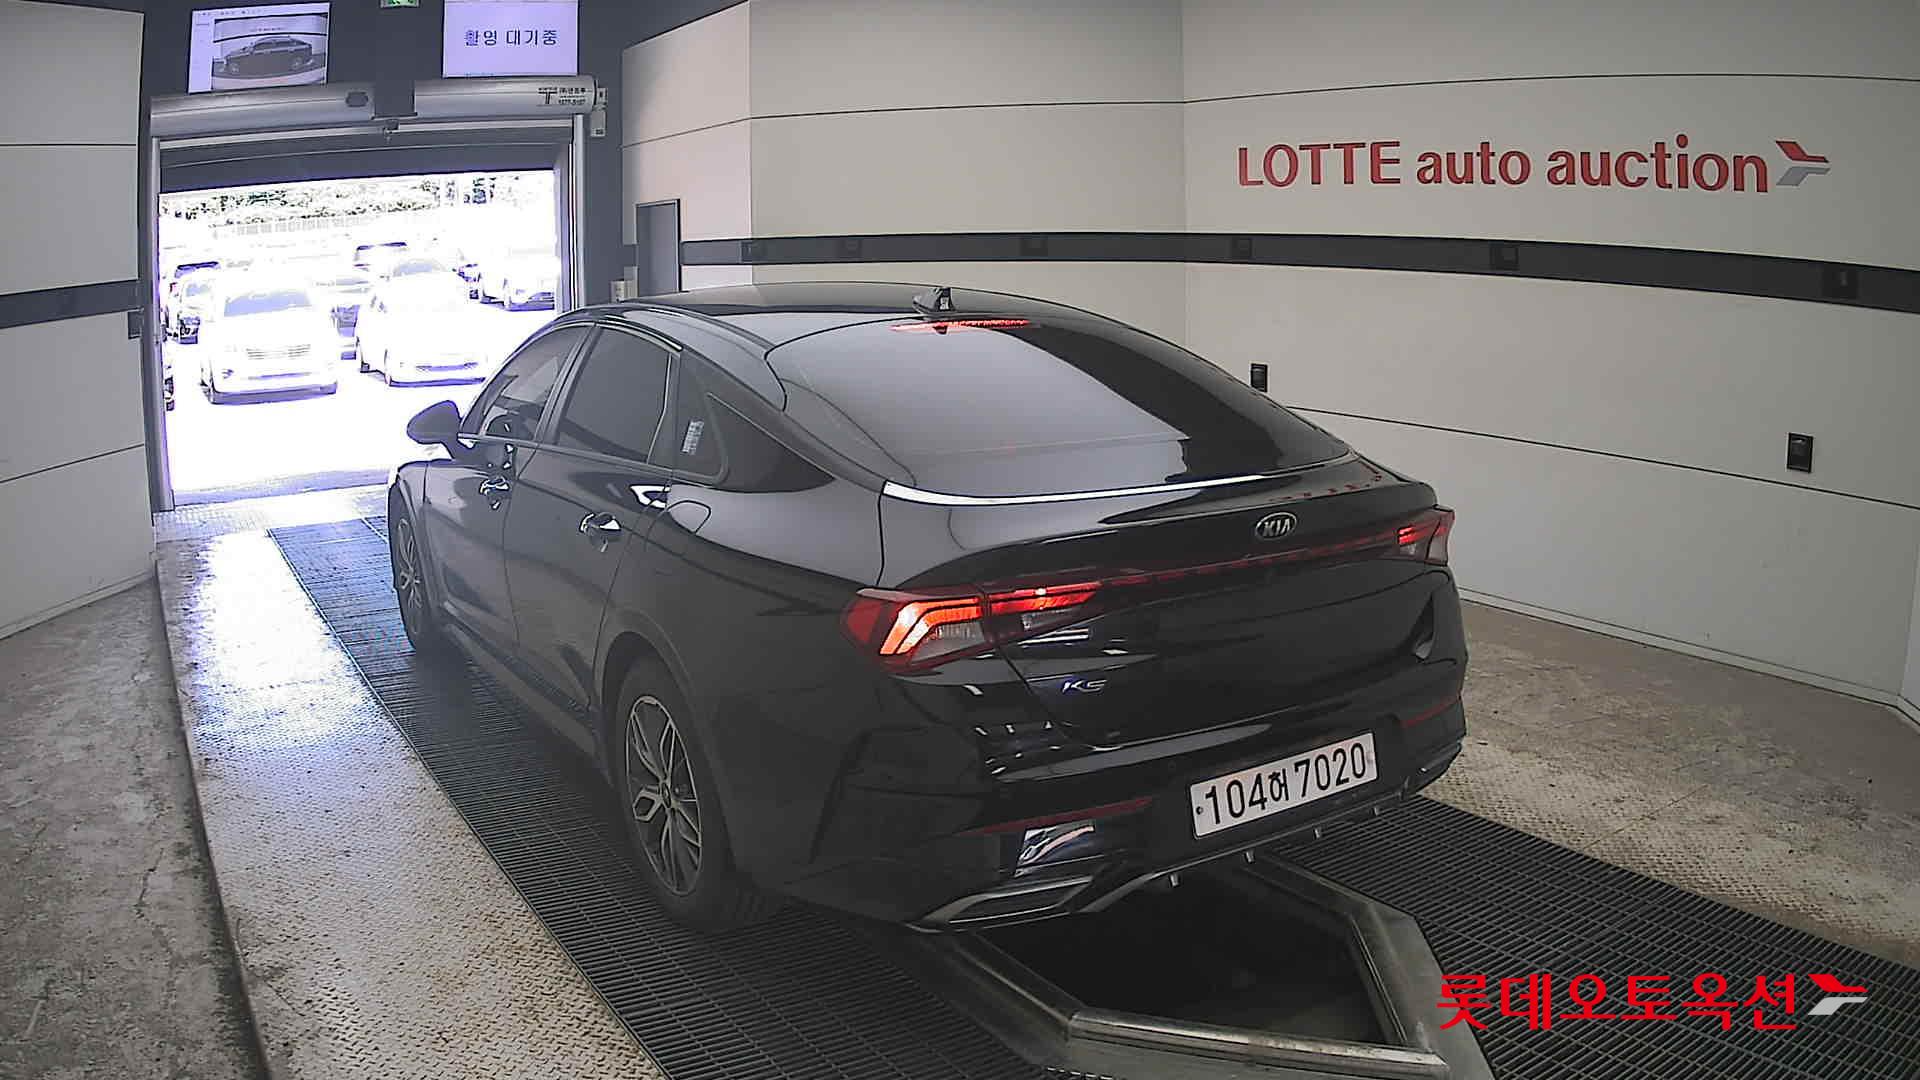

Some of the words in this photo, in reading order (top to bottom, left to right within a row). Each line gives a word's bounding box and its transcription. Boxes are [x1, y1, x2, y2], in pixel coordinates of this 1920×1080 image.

[506, 28, 559, 46] 대기중
[1238, 141, 1400, 187] LOTTE
[1416, 141, 1532, 185] auto
[1547, 134, 1768, 193] auction
[1261, 517, 1292, 538] KIA
[1294, 742, 1367, 798] 7020
